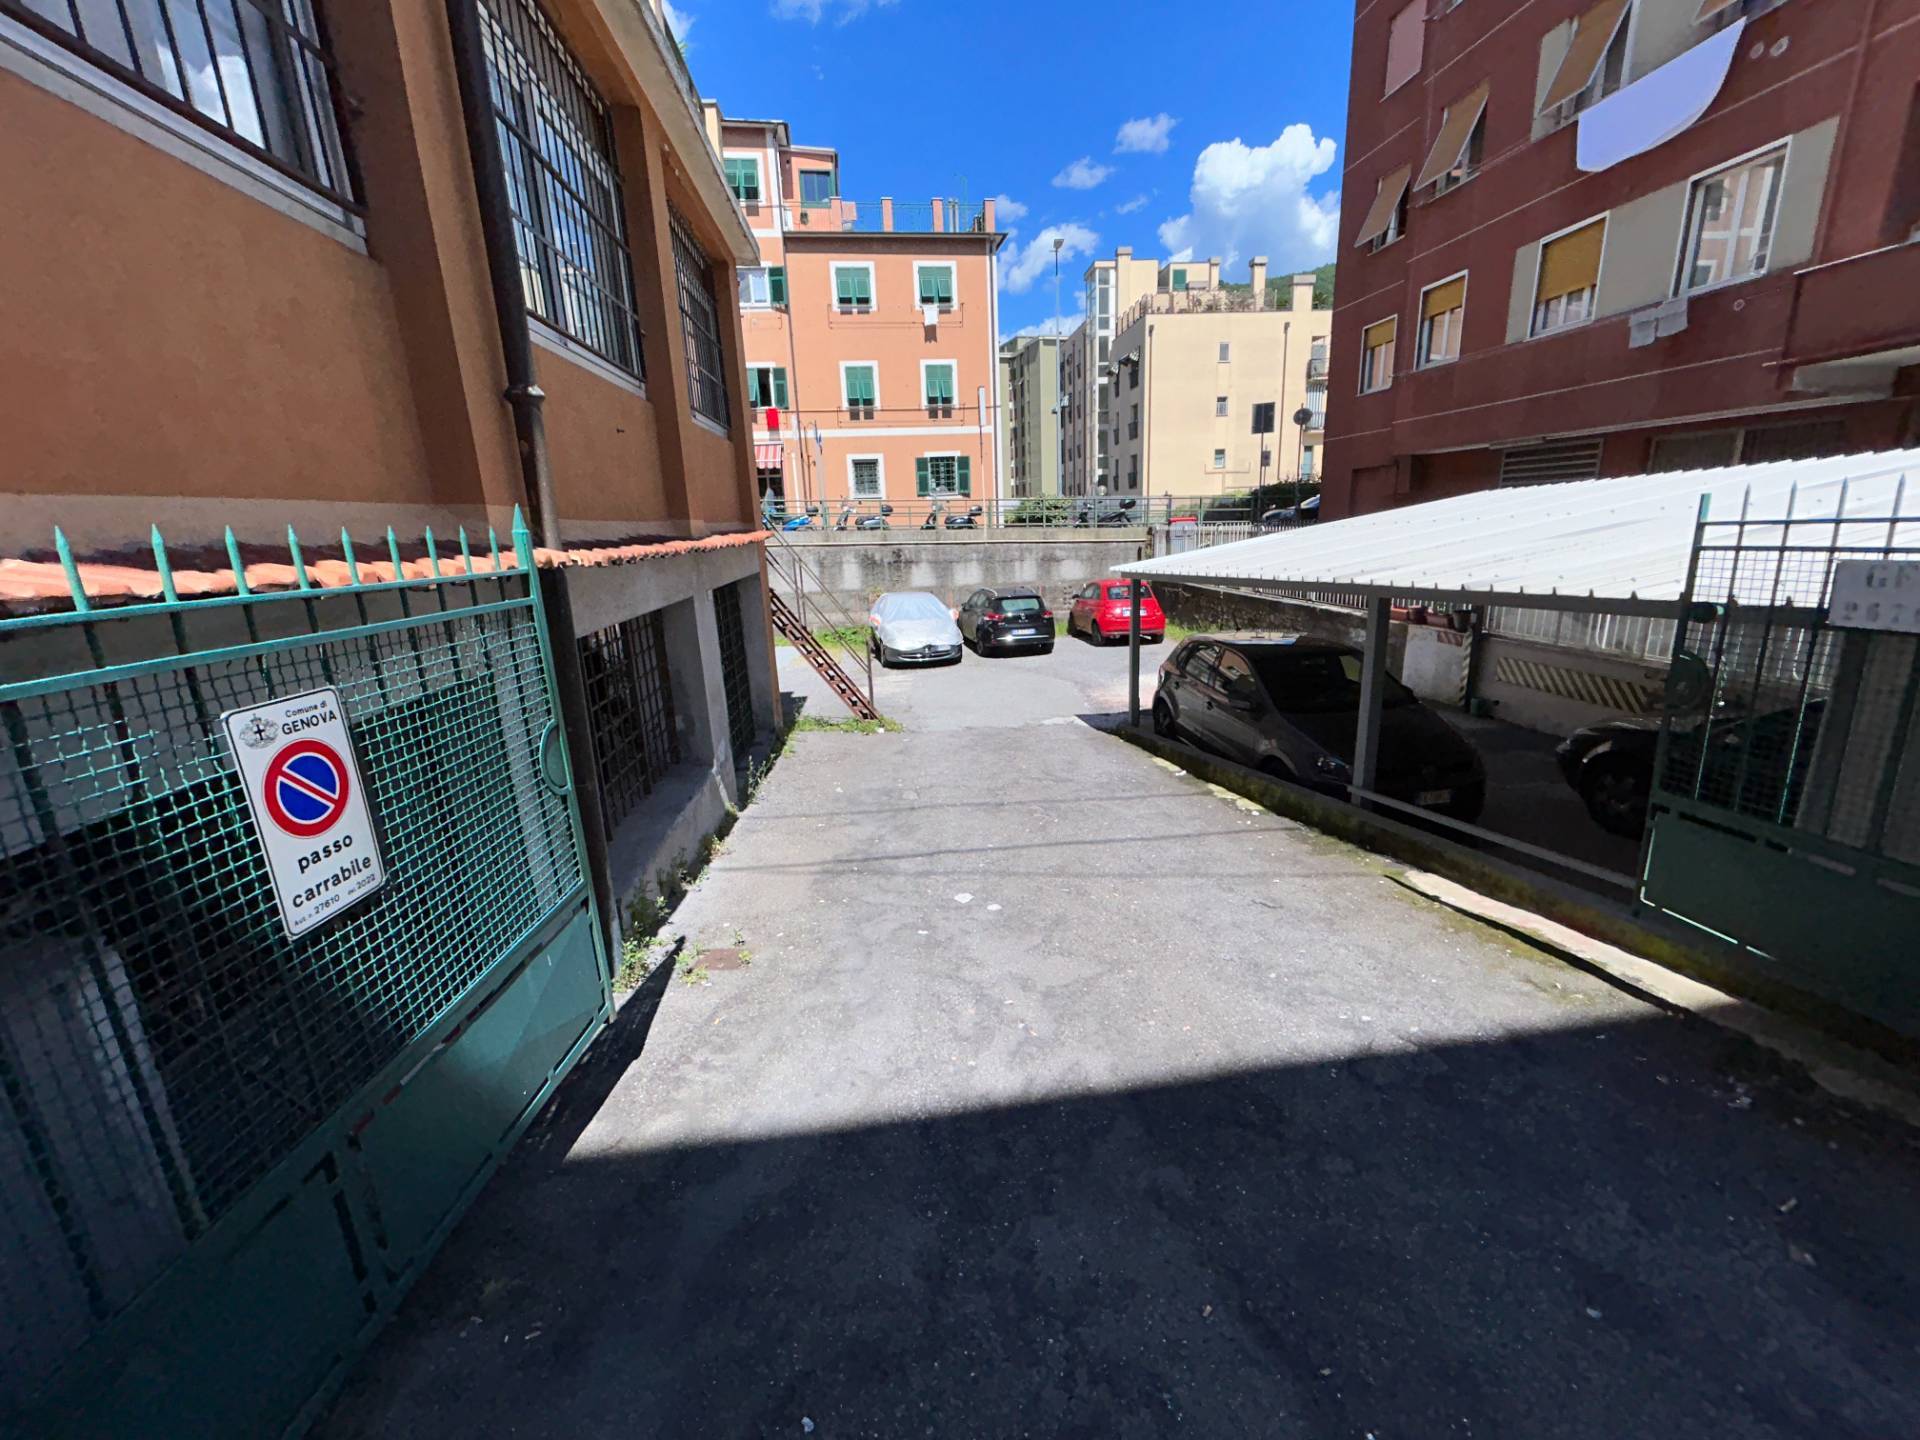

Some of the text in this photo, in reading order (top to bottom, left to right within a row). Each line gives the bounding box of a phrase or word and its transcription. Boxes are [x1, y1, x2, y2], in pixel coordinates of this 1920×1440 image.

[281, 710, 337, 735] GENOVA
[285, 704, 318, 718] Comune
[297, 834, 353, 875] passo
[292, 856, 372, 908] carrabile
